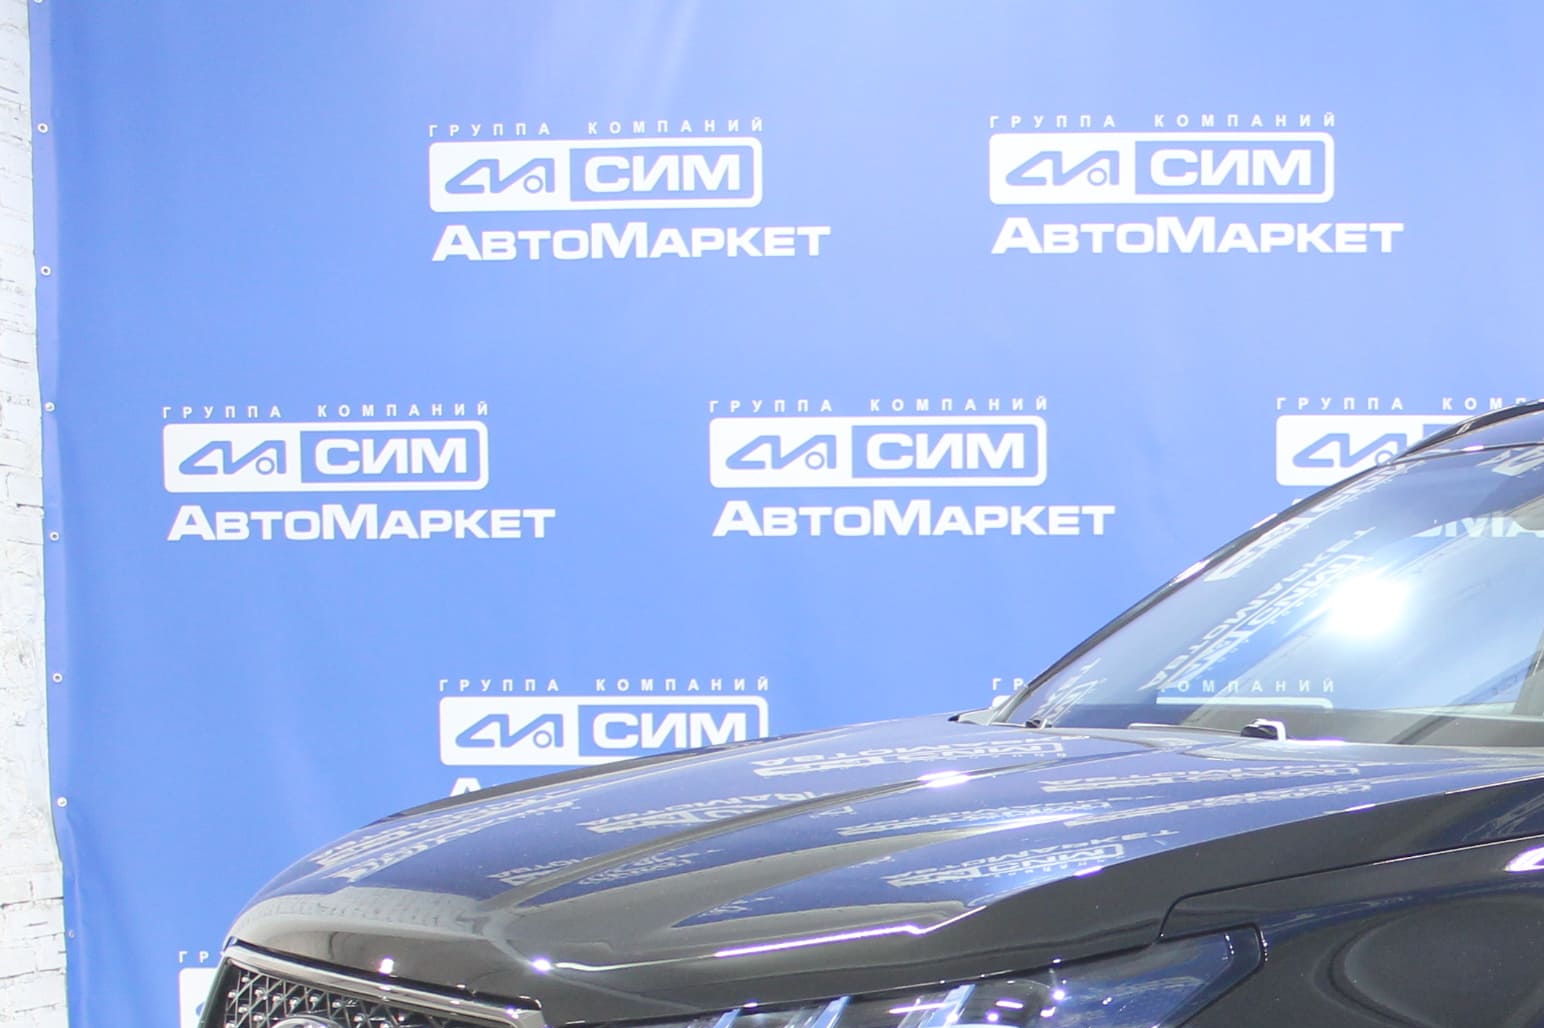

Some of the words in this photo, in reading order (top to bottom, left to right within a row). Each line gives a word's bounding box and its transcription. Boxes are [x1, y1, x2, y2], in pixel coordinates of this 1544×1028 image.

[428, 121, 550, 137] ГРУППА
[587, 116, 763, 135] КОМПАНИЙ
[989, 114, 1116, 129] ГРУППА
[1154, 111, 1335, 128] КОМПАНИЙ
[584, 153, 740, 193] СИМ
[1150, 148, 1312, 186] СИМ
[162, 405, 281, 419] ГРУППА
[317, 400, 488, 418] КОМПАНИЙ
[709, 398, 833, 413] ГРУППА
[869, 395, 1047, 412] КОМПАНИЙ
[1276, 396, 1403, 411] ГРУППА
[314, 437, 467, 475] СИМ
[866, 432, 1025, 470] СИМ
[439, 678, 559, 692] ГРУППА
[595, 675, 769, 692] КОМПАНИЙ
[1160, 677, 1335, 693] ОМПАНИЙ
[592, 711, 746, 749] СИМ
